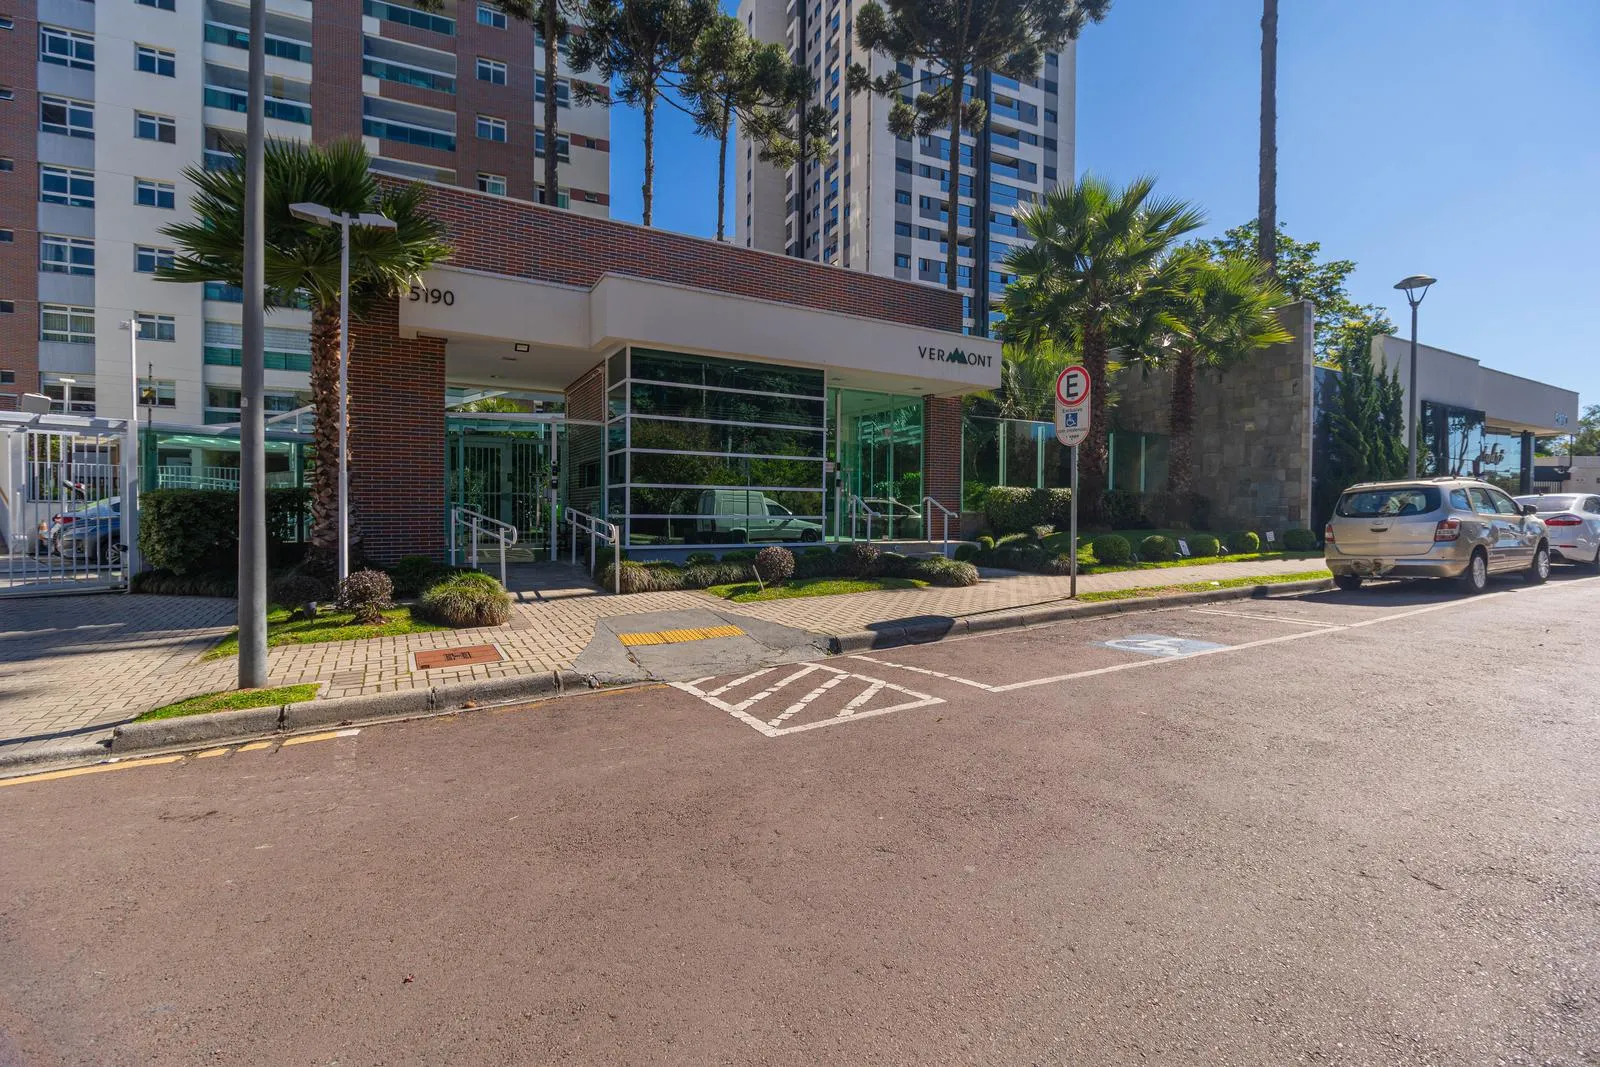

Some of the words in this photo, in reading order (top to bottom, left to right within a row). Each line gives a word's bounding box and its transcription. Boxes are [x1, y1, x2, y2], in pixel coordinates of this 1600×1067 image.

[409, 286, 454, 306] 5190
[918, 346, 992, 367] VERMONT
[1066, 374, 1079, 398] E
